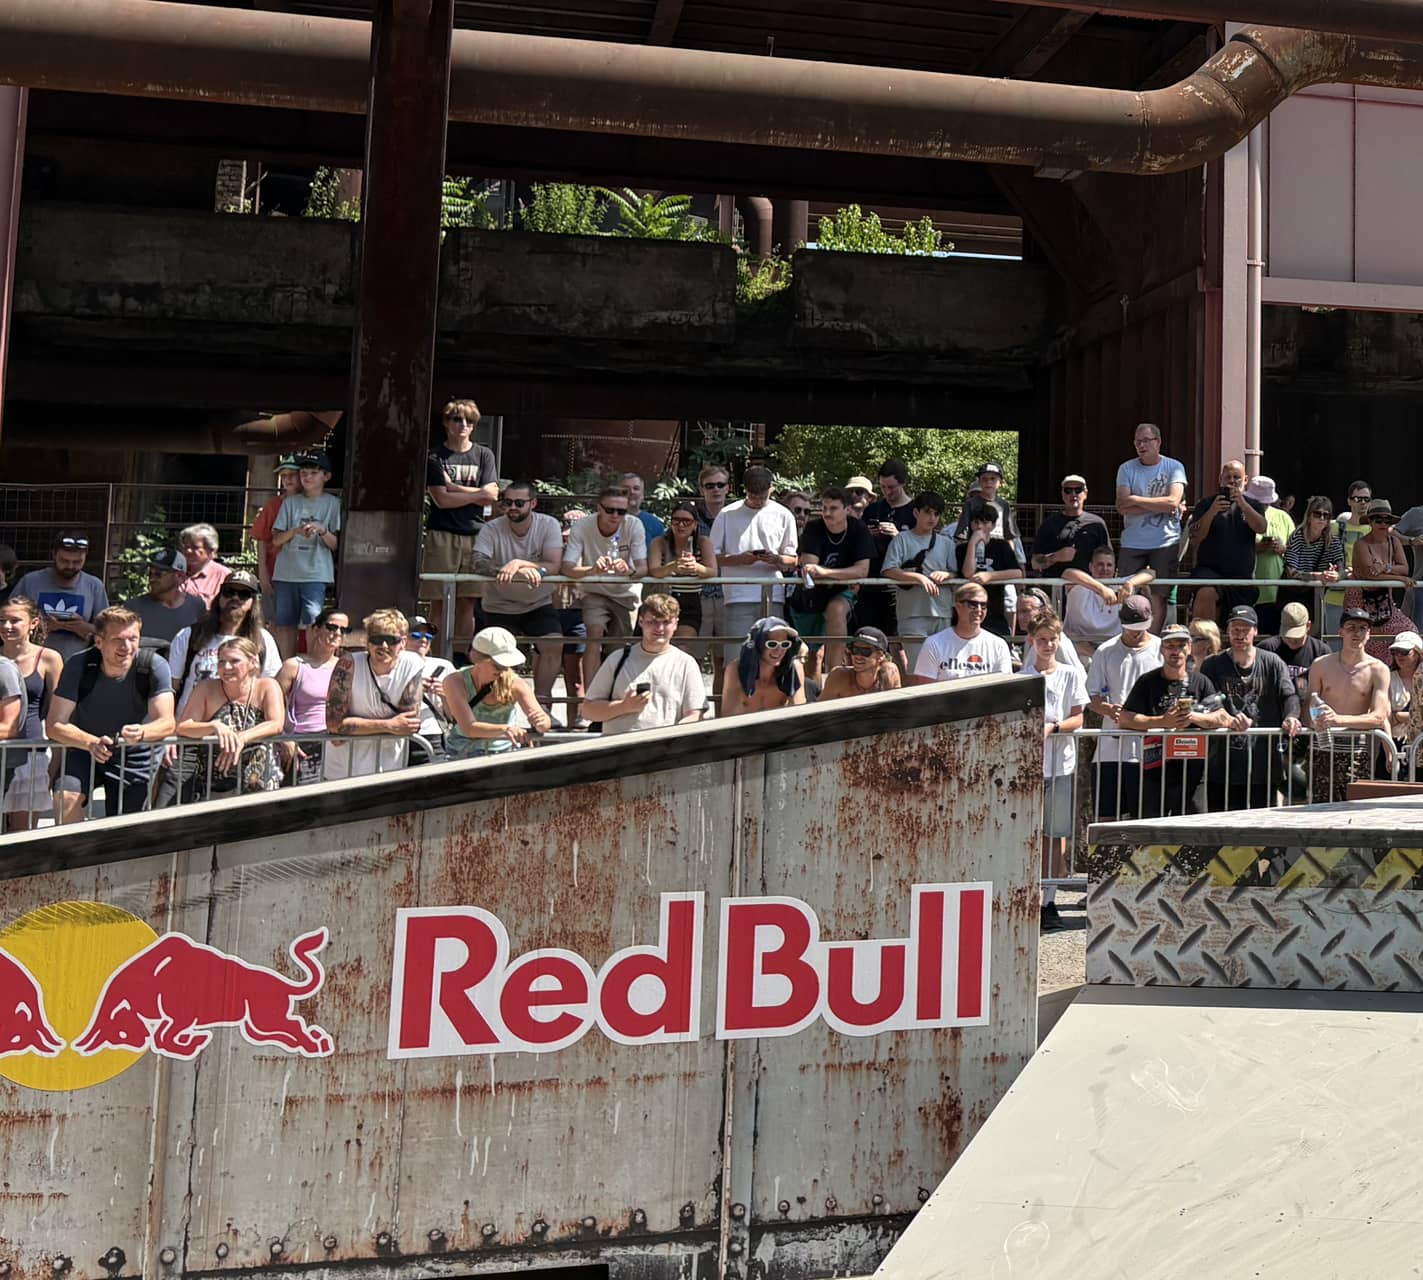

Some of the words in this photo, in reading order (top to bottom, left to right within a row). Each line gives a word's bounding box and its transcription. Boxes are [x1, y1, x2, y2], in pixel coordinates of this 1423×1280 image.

[939, 658, 991, 671] ellesse
[399, 901, 695, 1049] Red
[724, 890, 984, 1030] Bull
